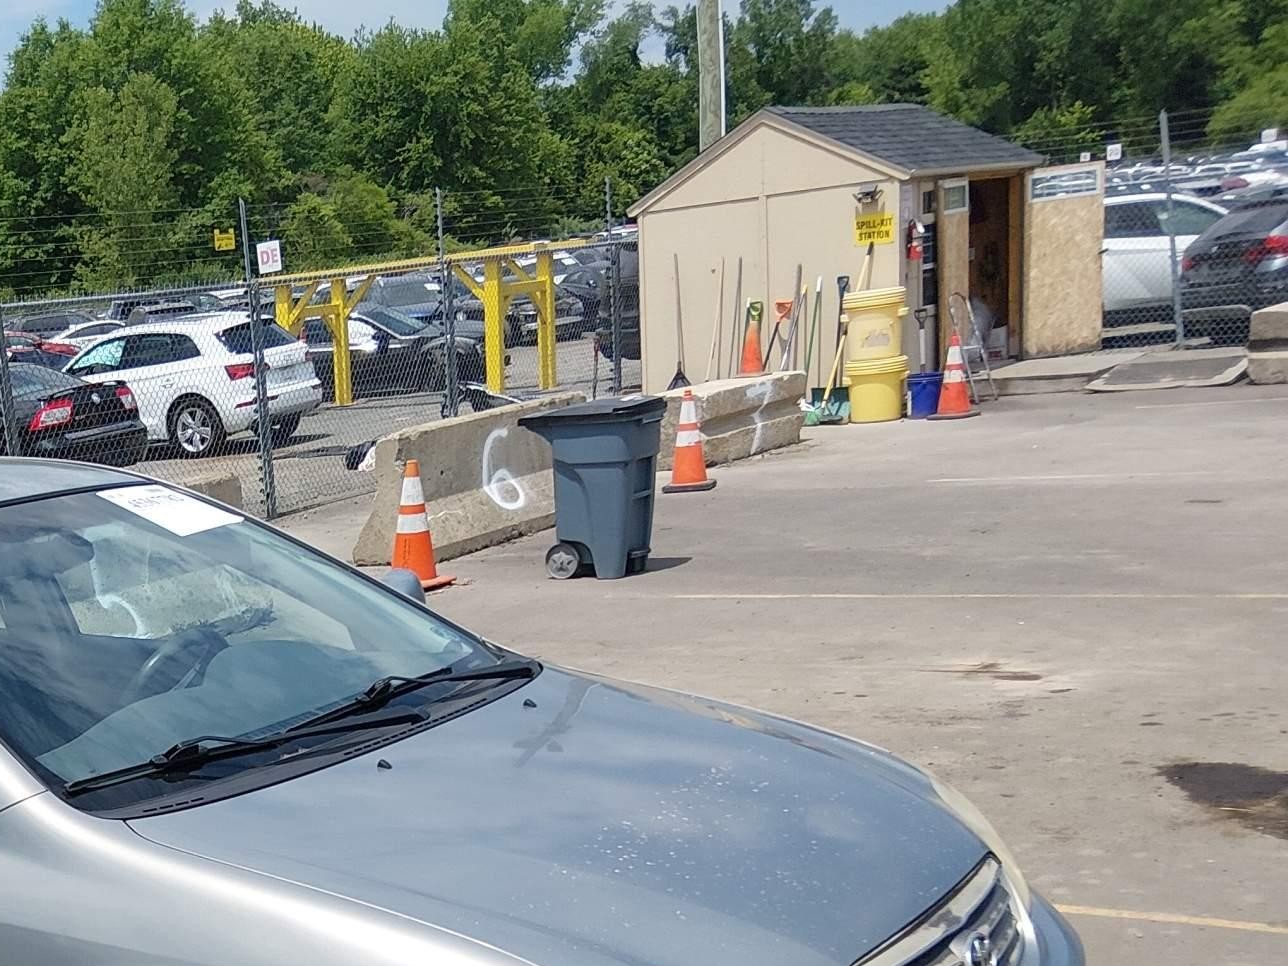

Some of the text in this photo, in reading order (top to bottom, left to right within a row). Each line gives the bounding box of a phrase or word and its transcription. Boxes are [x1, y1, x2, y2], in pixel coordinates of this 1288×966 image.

[856, 217, 892, 230] SPILL-KIT
[857, 230, 890, 241] STATION
[260, 248, 279, 265] DE
[482, 428, 525, 510] 6
